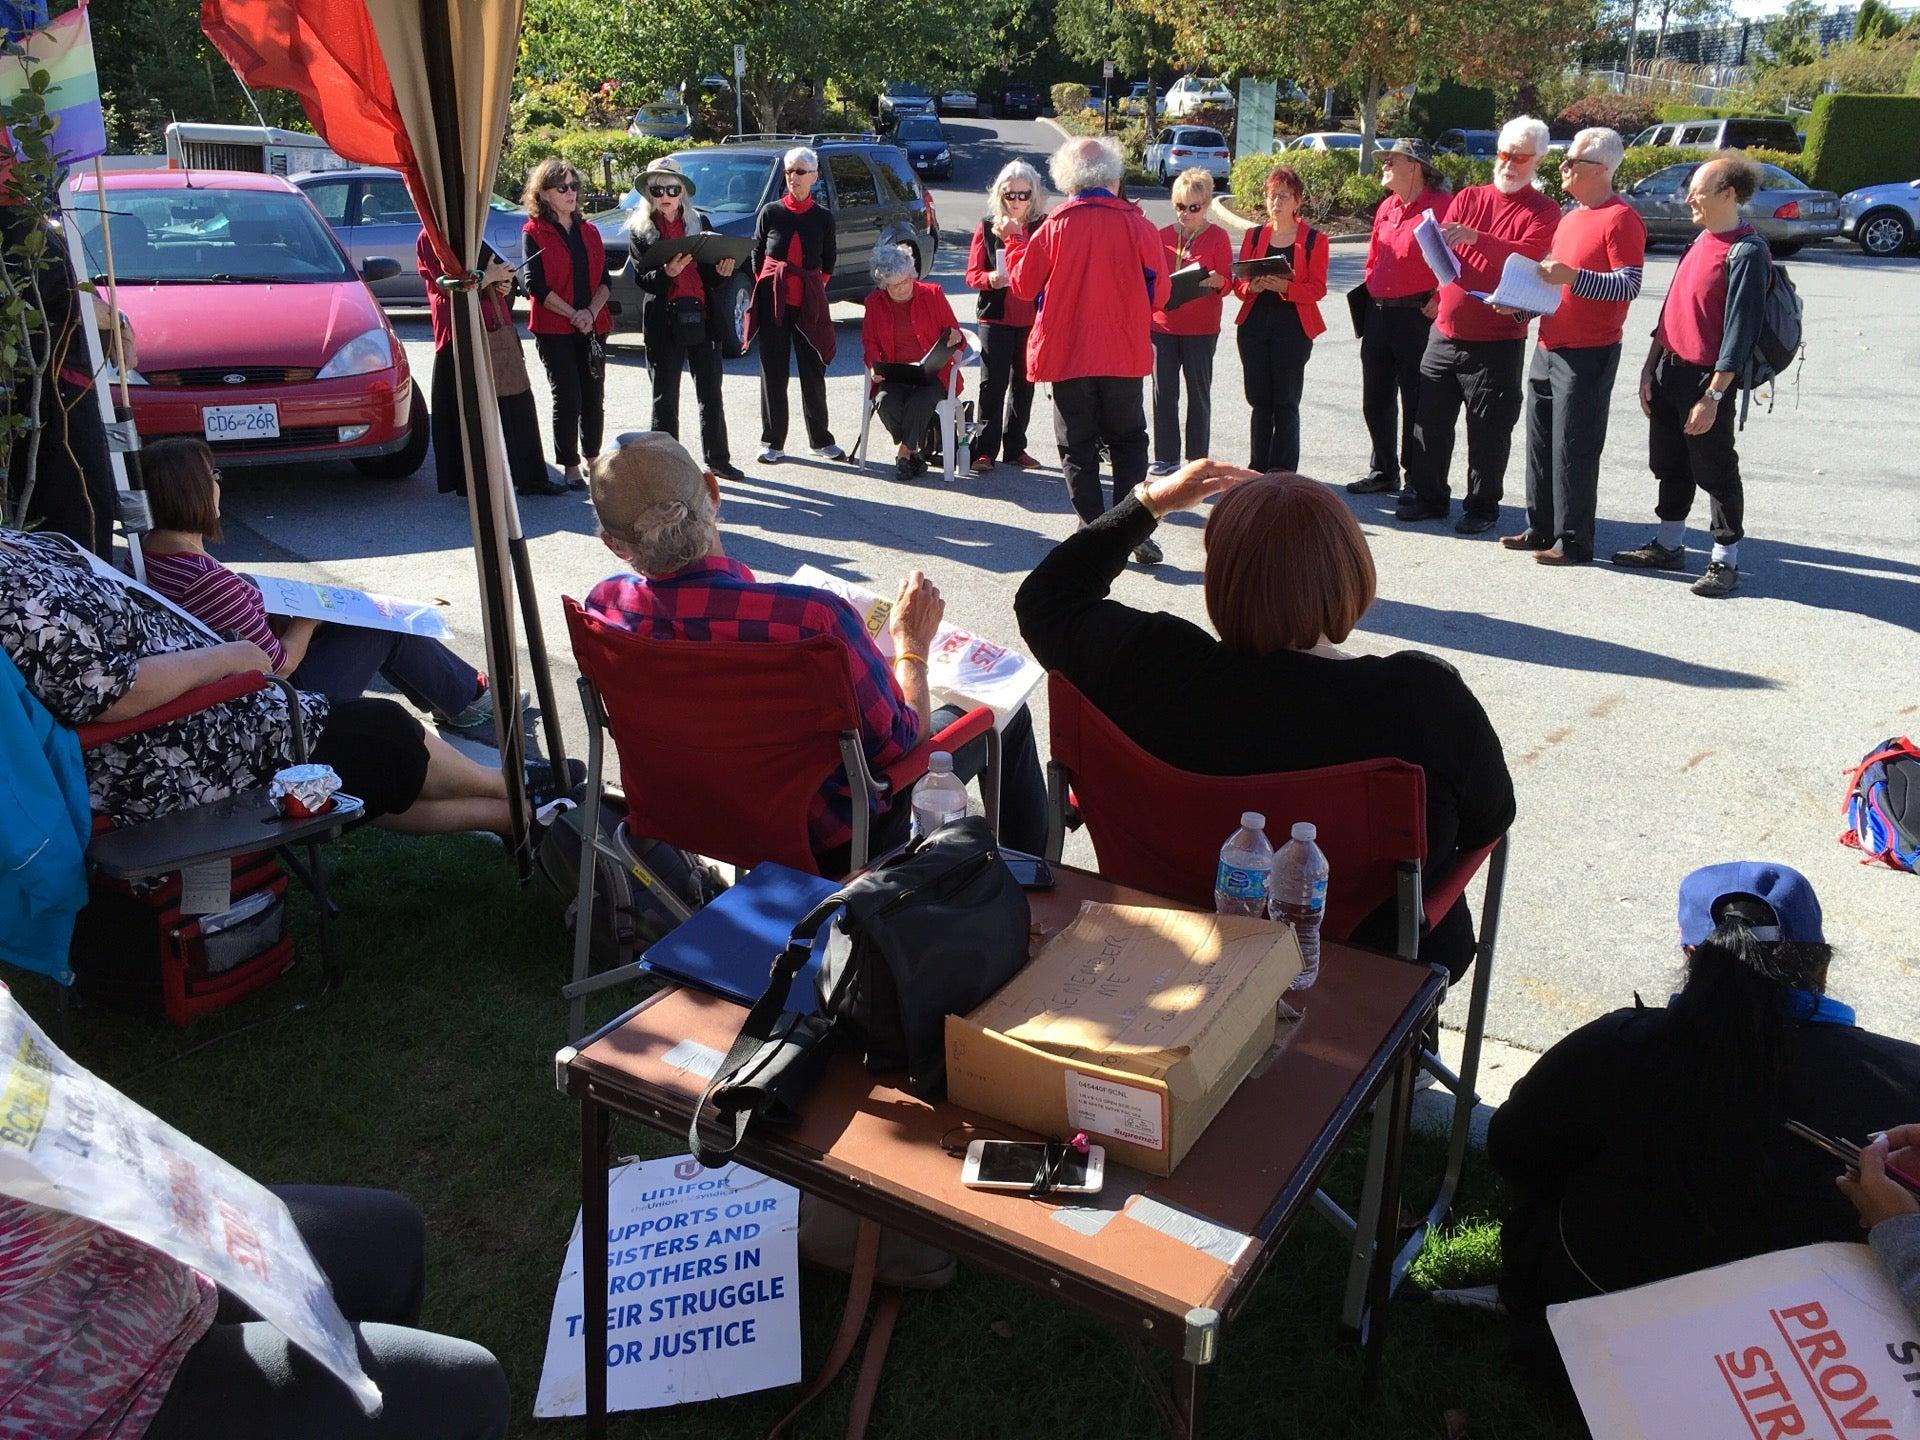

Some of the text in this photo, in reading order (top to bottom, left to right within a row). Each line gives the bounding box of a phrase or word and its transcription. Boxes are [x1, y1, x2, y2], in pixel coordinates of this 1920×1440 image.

[1096, 972, 1131, 998] ME
[607, 1197, 777, 1243] UPPORTS OUR
[704, 1223, 761, 1248] AND
[609, 1248, 761, 1295] ROTHERS IN
[565, 1276, 785, 1338] TEIR STRUGGLE
[606, 1319, 756, 1368] OR JUSTICE
[1725, 1346, 1815, 1440] STR
[1779, 1301, 1900, 1440] PROV
